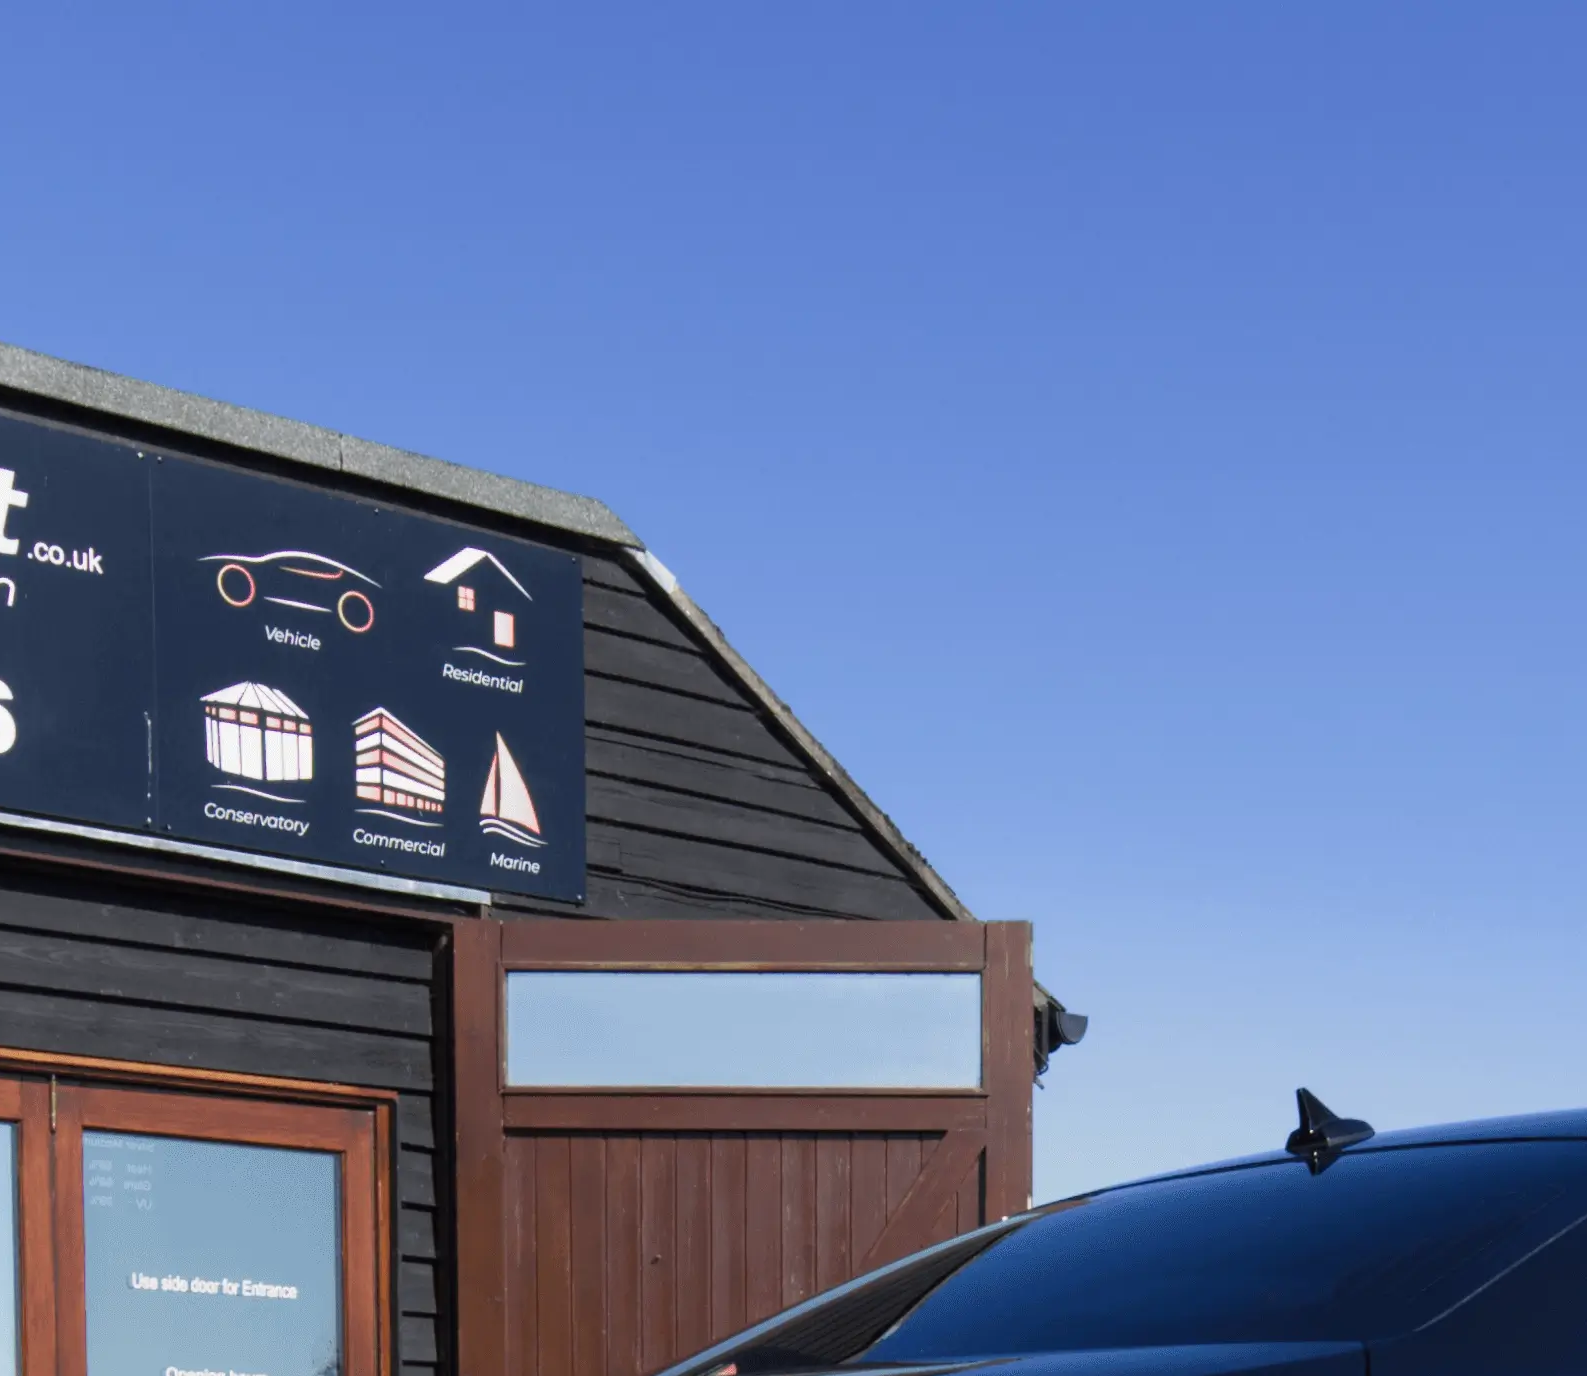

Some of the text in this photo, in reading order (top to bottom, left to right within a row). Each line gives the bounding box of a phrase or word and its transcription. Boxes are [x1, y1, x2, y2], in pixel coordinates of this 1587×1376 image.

[26, 541, 104, 575] .co.uk
[264, 624, 322, 650] Vehicle
[442, 663, 524, 694] Residential
[203, 802, 310, 837] Conservatory
[352, 828, 446, 858] Commercial
[489, 852, 541, 875] Marine
[131, 1271, 298, 1299] Use side door for Entrance
